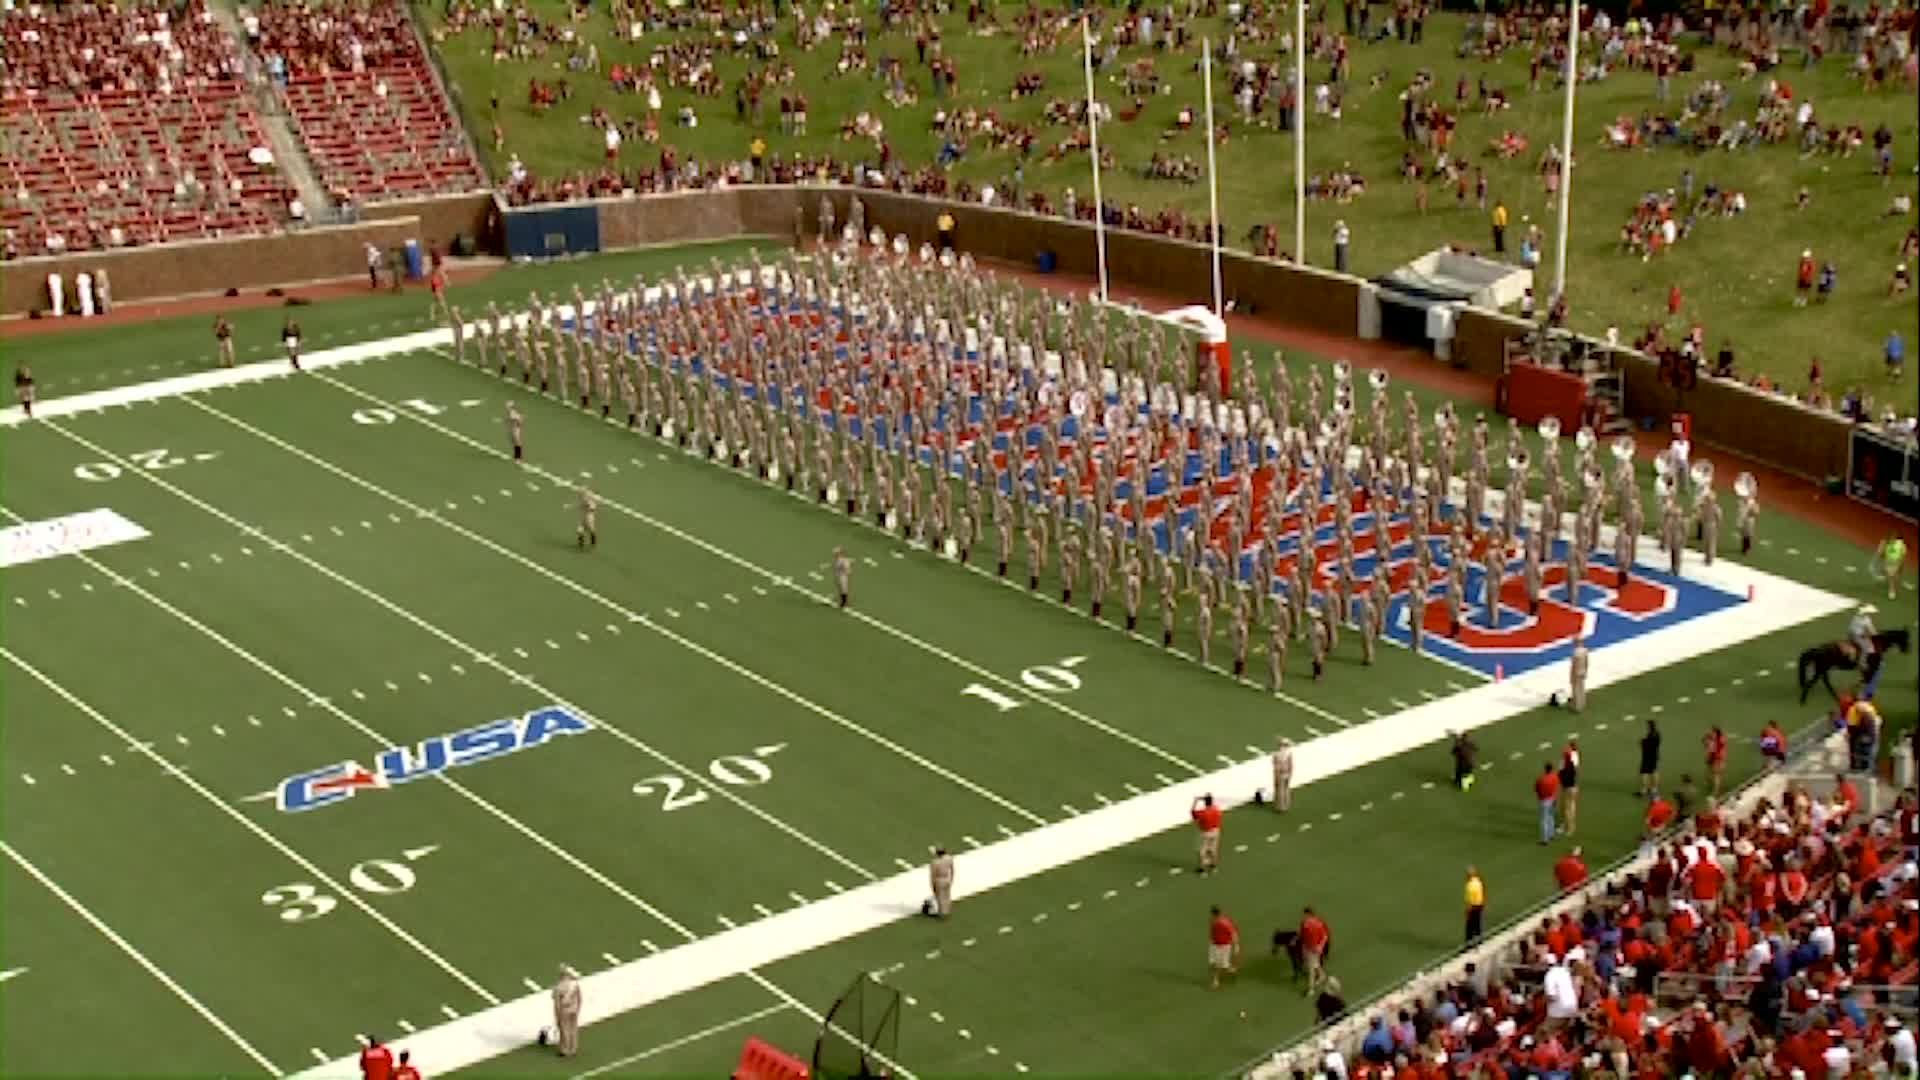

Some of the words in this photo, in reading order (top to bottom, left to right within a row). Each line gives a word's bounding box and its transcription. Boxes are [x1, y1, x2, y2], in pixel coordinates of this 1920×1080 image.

[73, 448, 187, 482] 20
[961, 665, 1082, 712] 10
[632, 754, 773, 812] 20
[261, 859, 417, 923] 30
